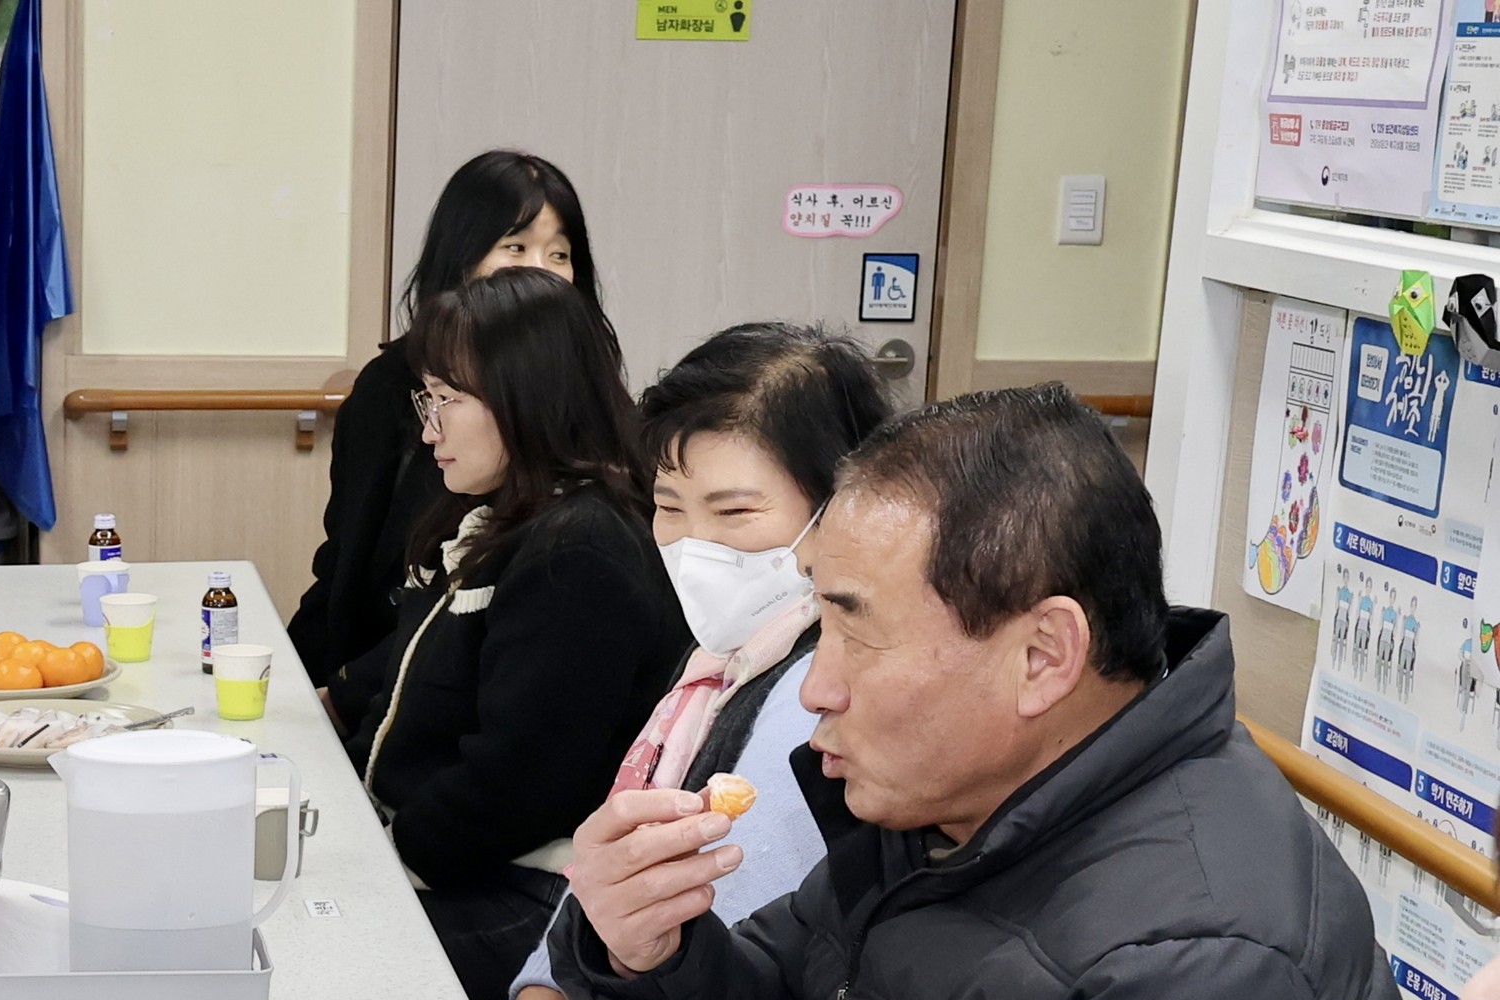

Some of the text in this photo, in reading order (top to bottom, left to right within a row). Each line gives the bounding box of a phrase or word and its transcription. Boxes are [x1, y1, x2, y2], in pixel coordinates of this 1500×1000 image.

[656, 19, 714, 32] 남자화장실
[791, 192, 818, 206] 식사
[853, 195, 892, 210] 어르신
[1335, 526, 1343, 543] 2
[1359, 537, 1385, 561] 인사하기
[1442, 565, 1451, 584] 3
[1315, 722, 1321, 738] 4
[1417, 775, 1473, 819] 5 악기 연주하기
[1393, 960, 1400, 977] 7
[1406, 970, 1421, 991] 온몸
